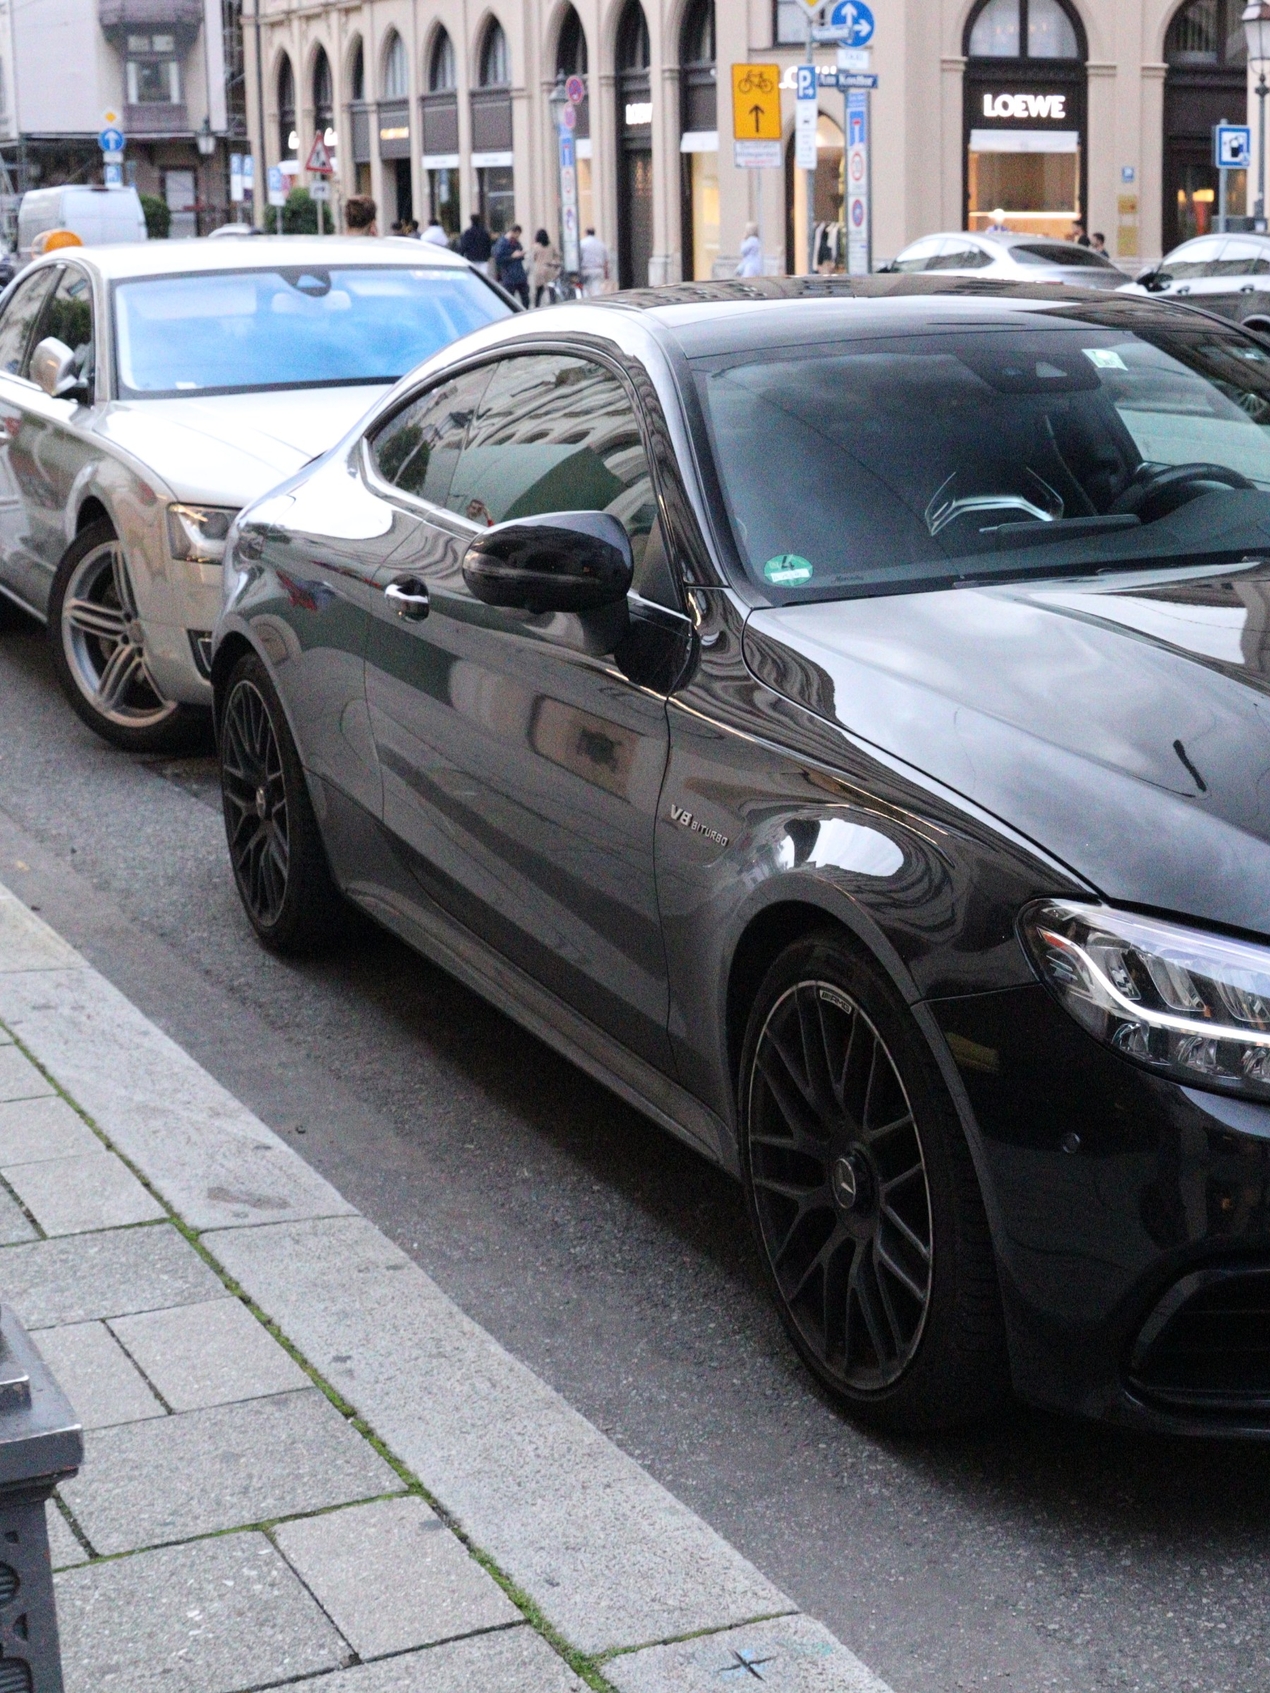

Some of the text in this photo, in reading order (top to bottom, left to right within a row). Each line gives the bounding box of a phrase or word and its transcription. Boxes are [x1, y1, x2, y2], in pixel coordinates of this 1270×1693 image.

[983, 93, 1066, 119] LOEWE
[781, 555, 795, 570] 4
[671, 804, 728, 848] V8 BITURBO
